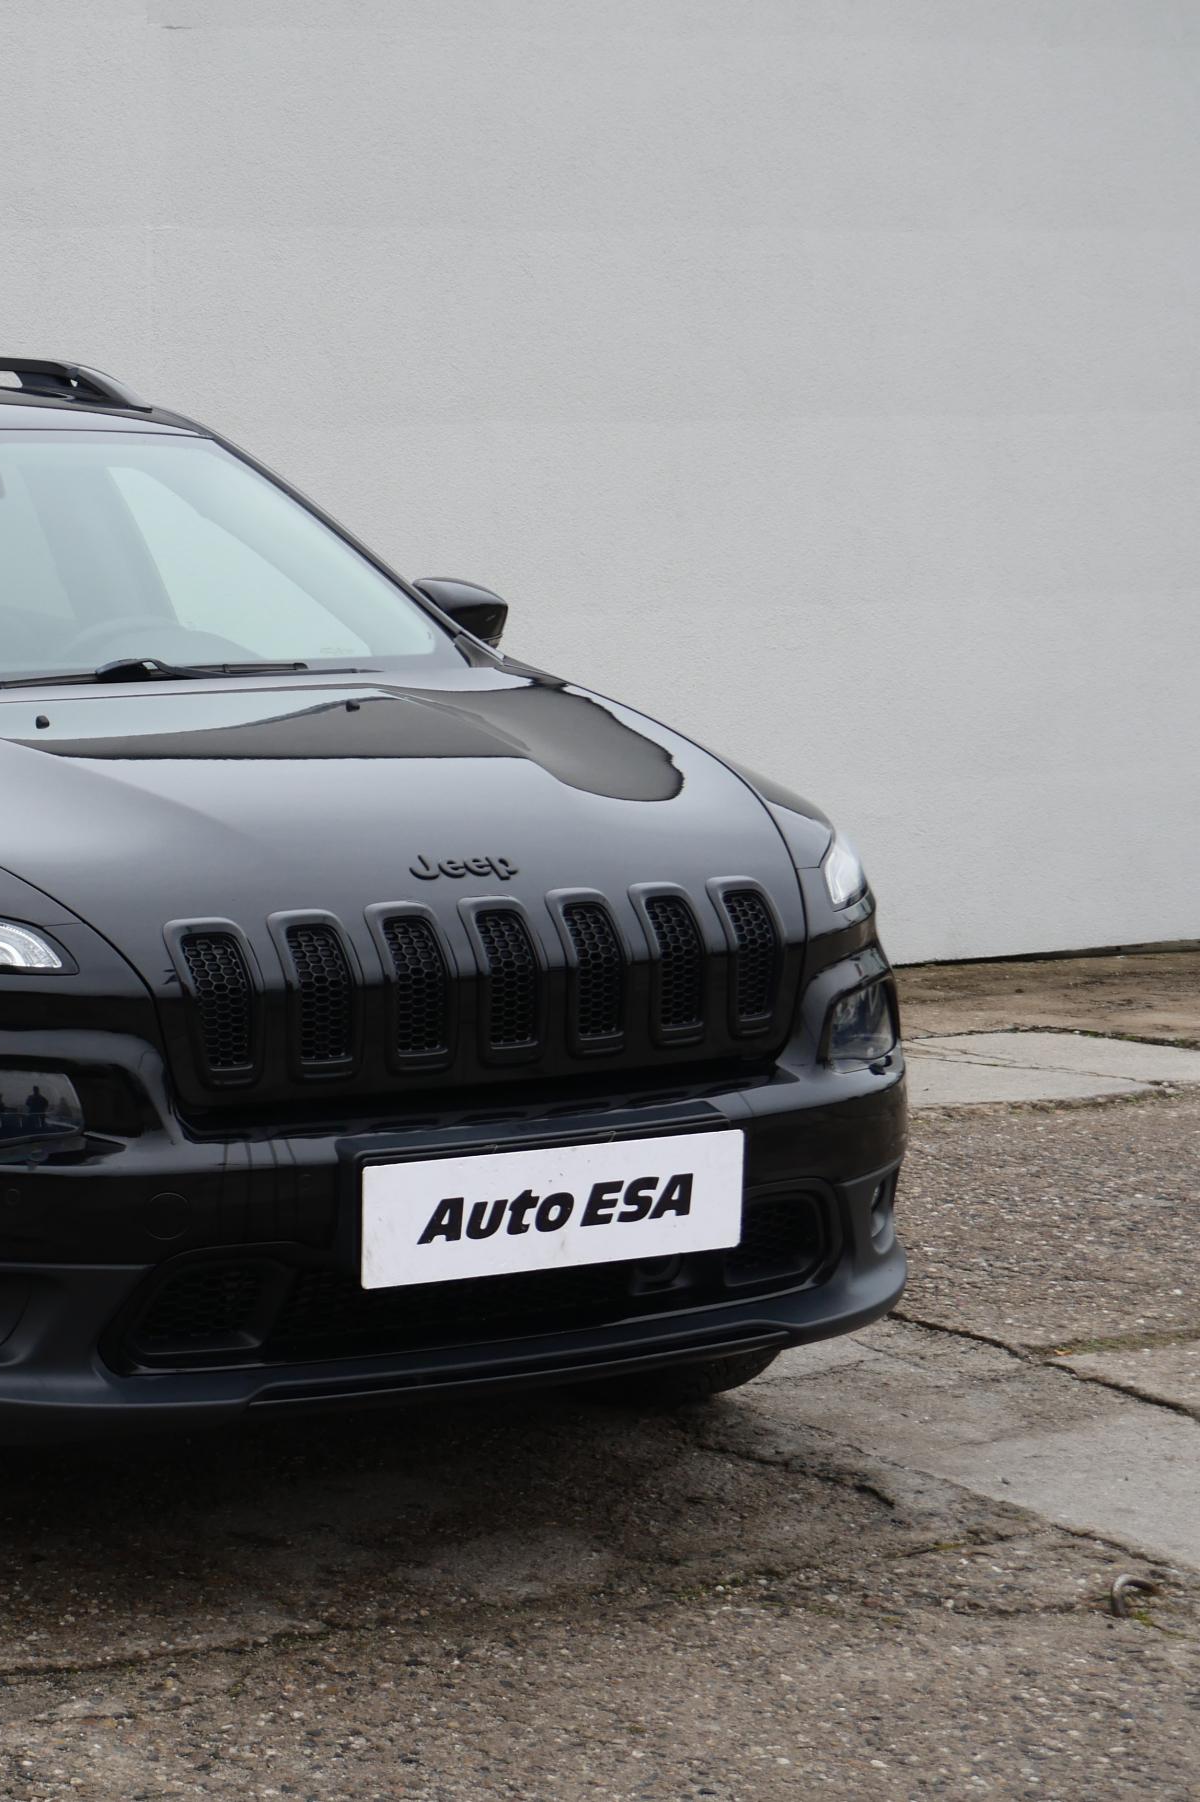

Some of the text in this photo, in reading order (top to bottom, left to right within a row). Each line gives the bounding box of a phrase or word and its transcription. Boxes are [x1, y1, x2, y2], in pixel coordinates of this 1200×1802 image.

[409, 854, 518, 881] Jeep
[417, 1173, 693, 1245] Auto ESA
